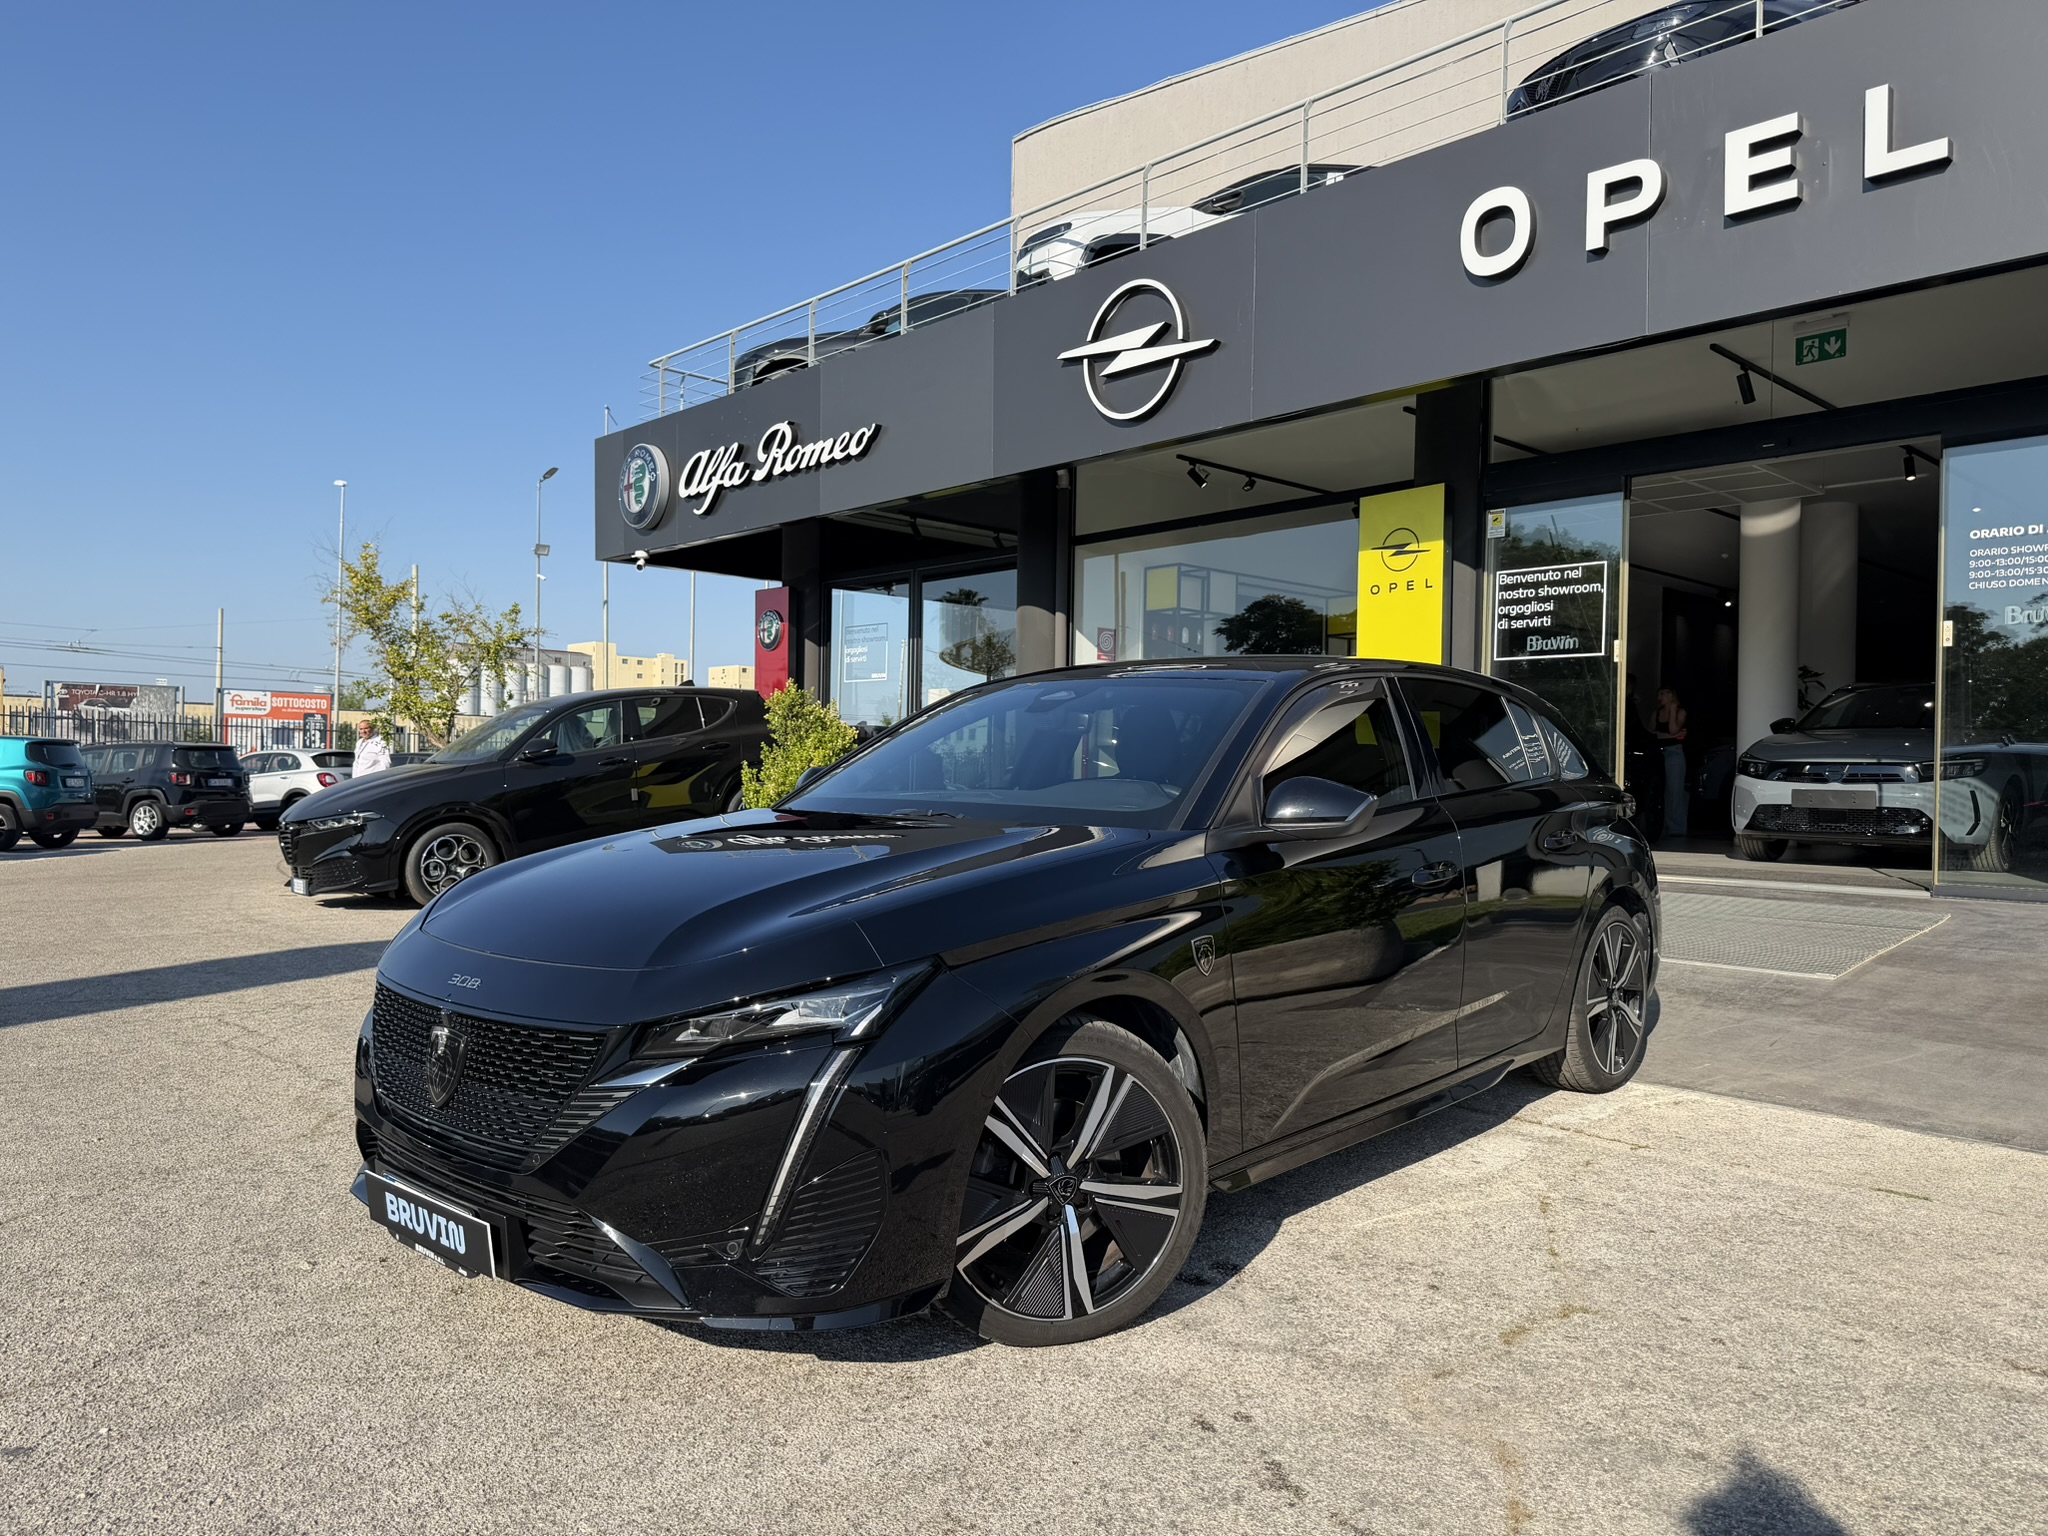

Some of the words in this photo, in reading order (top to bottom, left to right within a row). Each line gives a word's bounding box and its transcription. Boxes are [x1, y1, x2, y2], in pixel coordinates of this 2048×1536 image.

[1460, 84, 1951, 277] OPEL
[634, 449, 657, 482] ROMEO
[678, 441, 750, 515] Alfa
[752, 420, 877, 482] Romeo
[1969, 526, 2025, 539] ORARIO
[2028, 524, 2044, 535] DI
[1969, 547, 2009, 557] ORARIO
[1499, 569, 1561, 585] Benvenuto
[1564, 566, 1582, 579] nel
[1370, 578, 1433, 595] OPEL
[1499, 587, 1536, 600] nostro
[1538, 583, 1604, 597] showroom,
[1968, 580, 2007, 590] CHIUSO
[1498, 600, 1554, 616] orgogliosi
[1497, 618, 1509, 629] di
[1510, 615, 1551, 629] servirti
[230, 694, 267, 707] famila
[271, 697, 327, 709] SOTTOCOSTO
[448, 973, 481, 988] 308
[385, 1191, 466, 1255] BRUVIN
